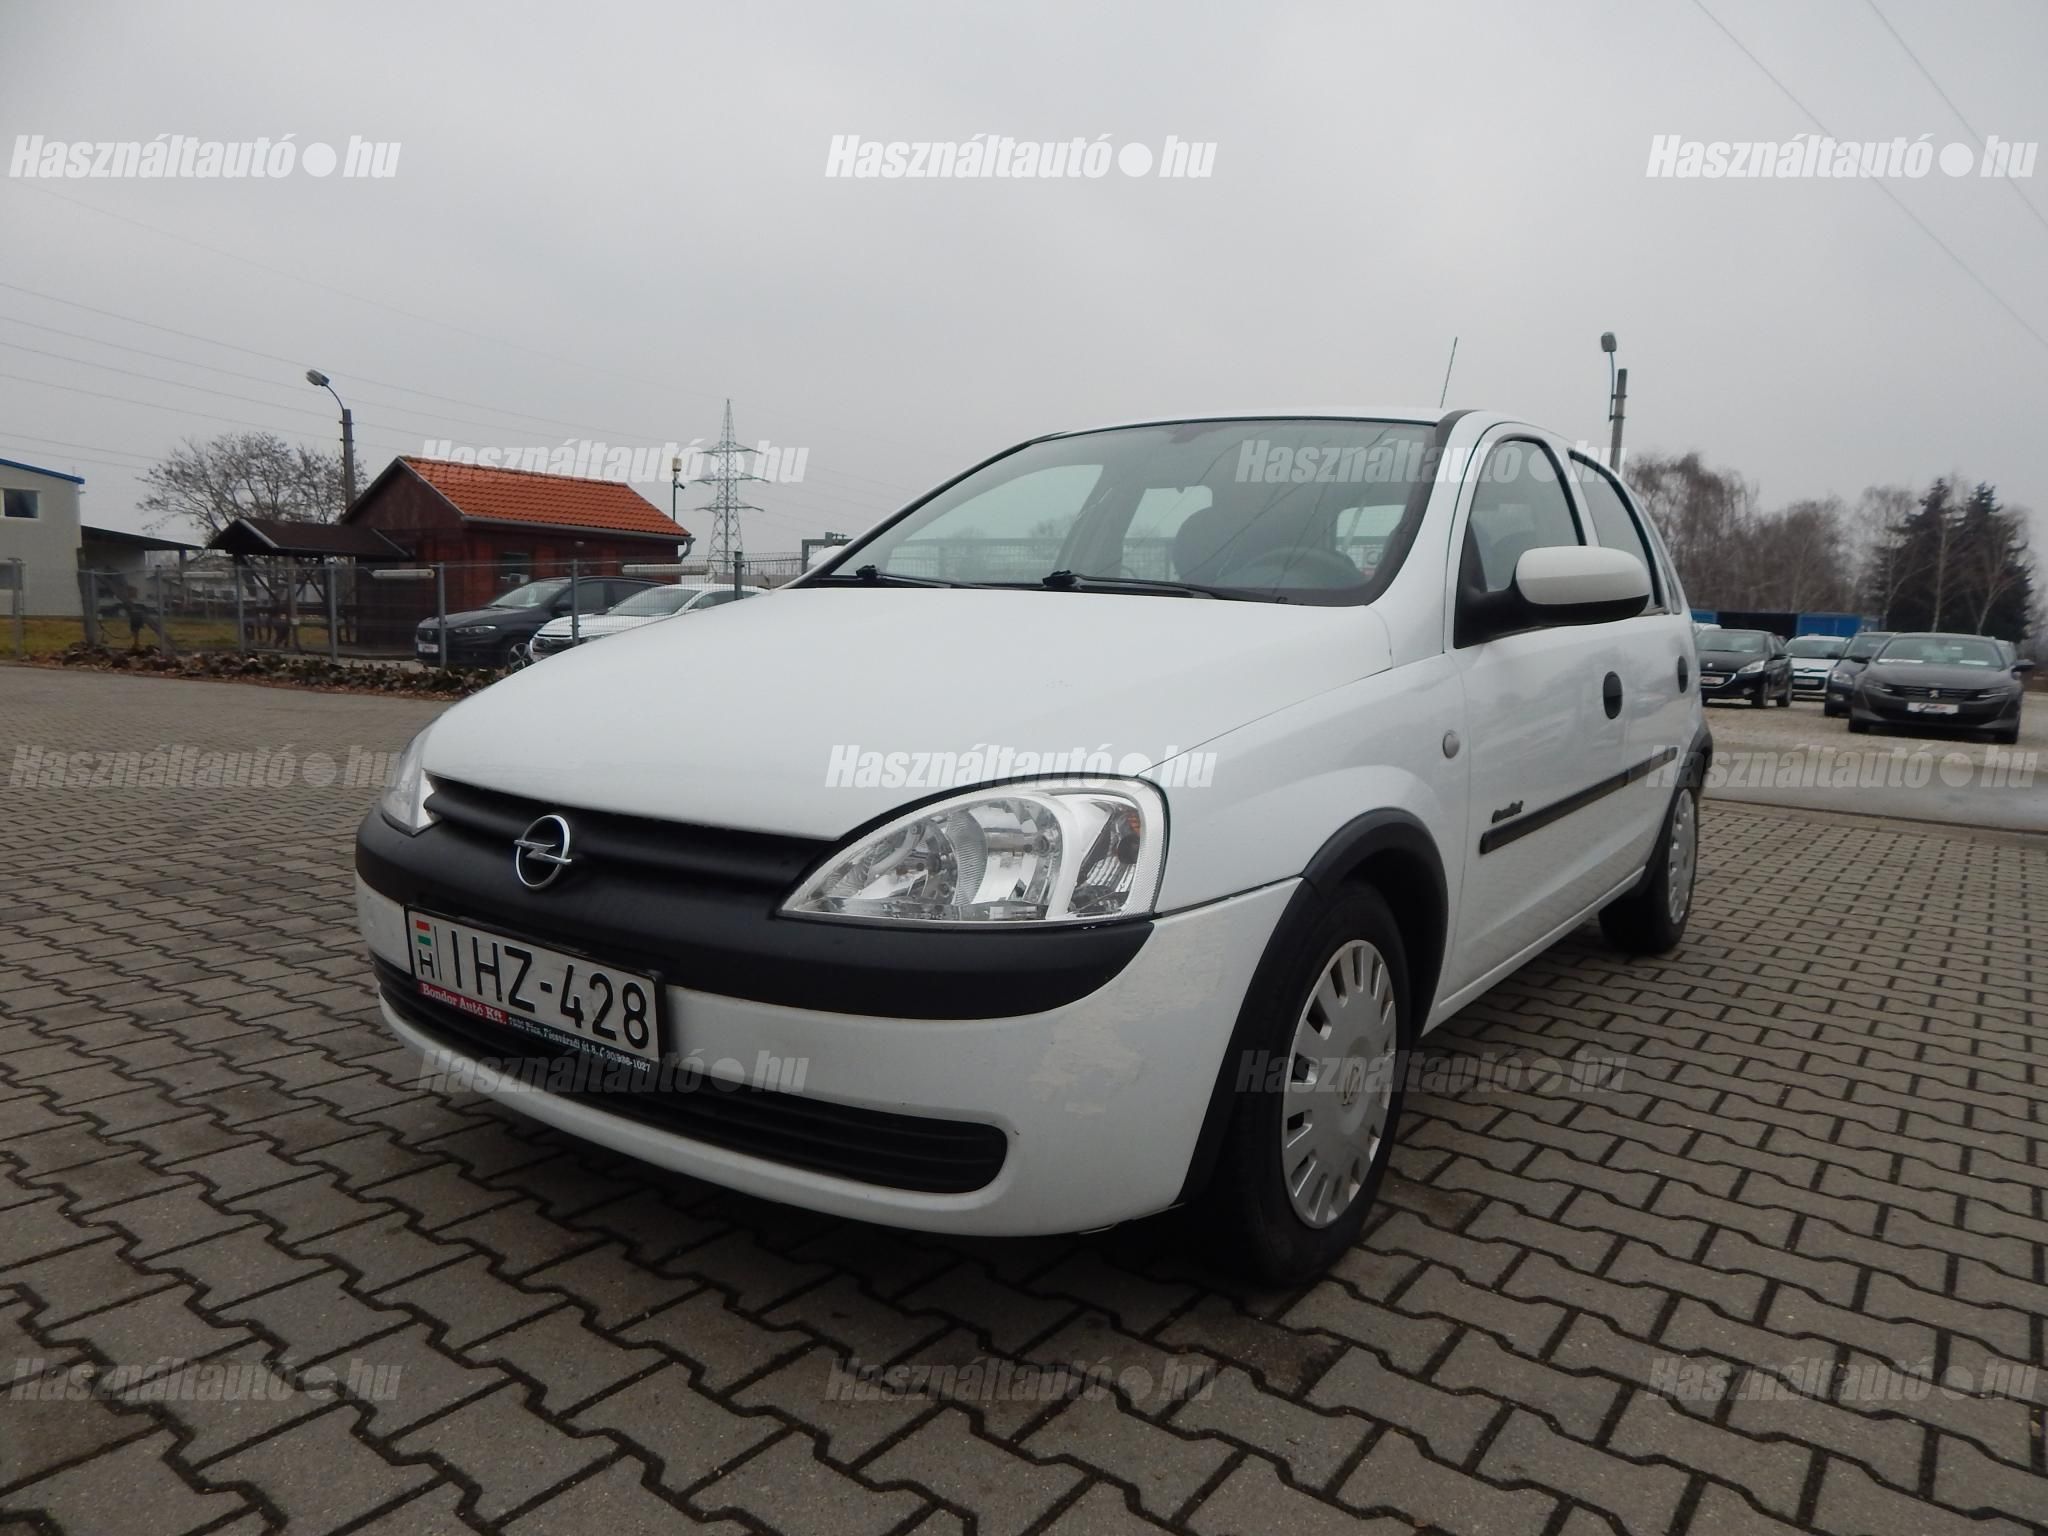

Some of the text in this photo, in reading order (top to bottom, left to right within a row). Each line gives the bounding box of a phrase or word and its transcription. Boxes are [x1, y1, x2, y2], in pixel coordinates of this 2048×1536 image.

[418, 928, 650, 1050] H IHZ-428
[421, 983, 457, 1007] Bondor
[459, 998, 484, 1017] Autó
[485, 1006, 508, 1025] Kft.
